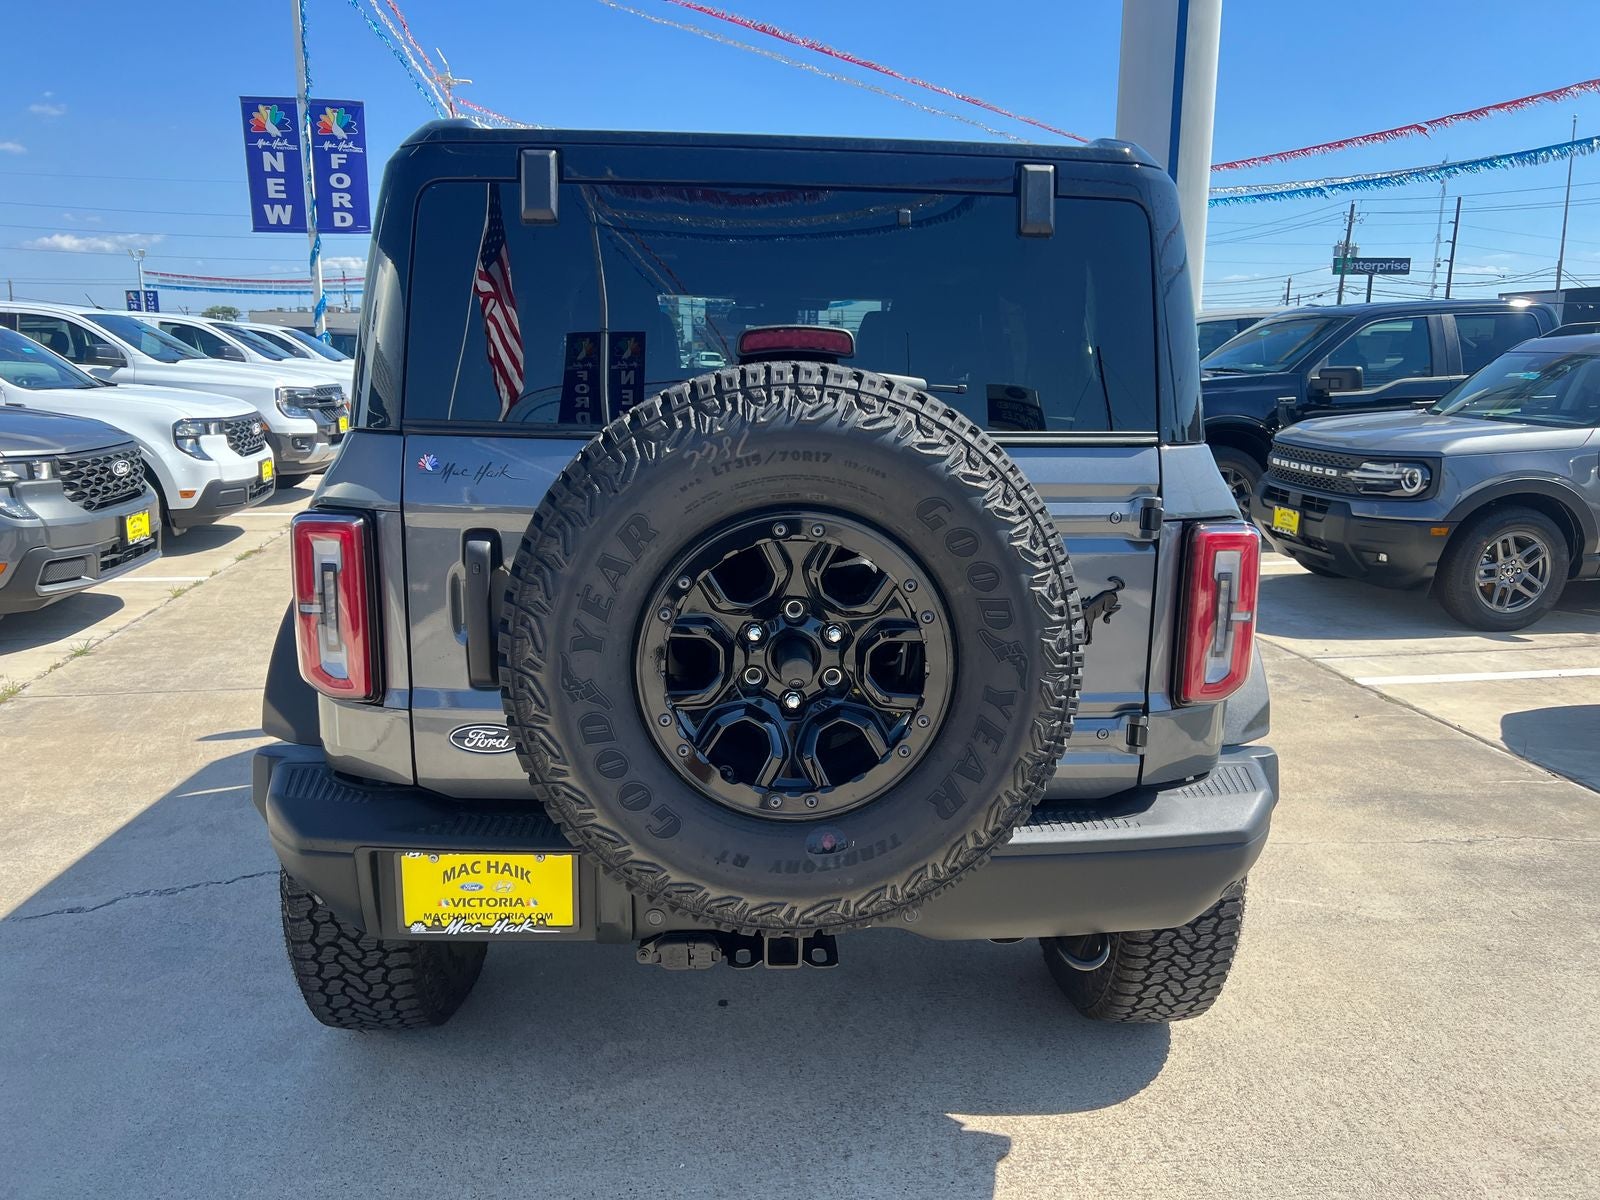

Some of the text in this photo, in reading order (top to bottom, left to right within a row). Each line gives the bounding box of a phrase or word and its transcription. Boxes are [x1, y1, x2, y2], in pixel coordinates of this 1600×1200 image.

[262, 151, 293, 225] NEW
[329, 153, 353, 227] FORD
[431, 461, 521, 485] Mac Haik
[1272, 457, 1338, 476] BRONCO
[464, 729, 510, 748] Ford
[442, 860, 532, 885] MAC HAIK
[450, 897, 526, 908] VICTORIA
[430, 917, 546, 935] Mac Haik
